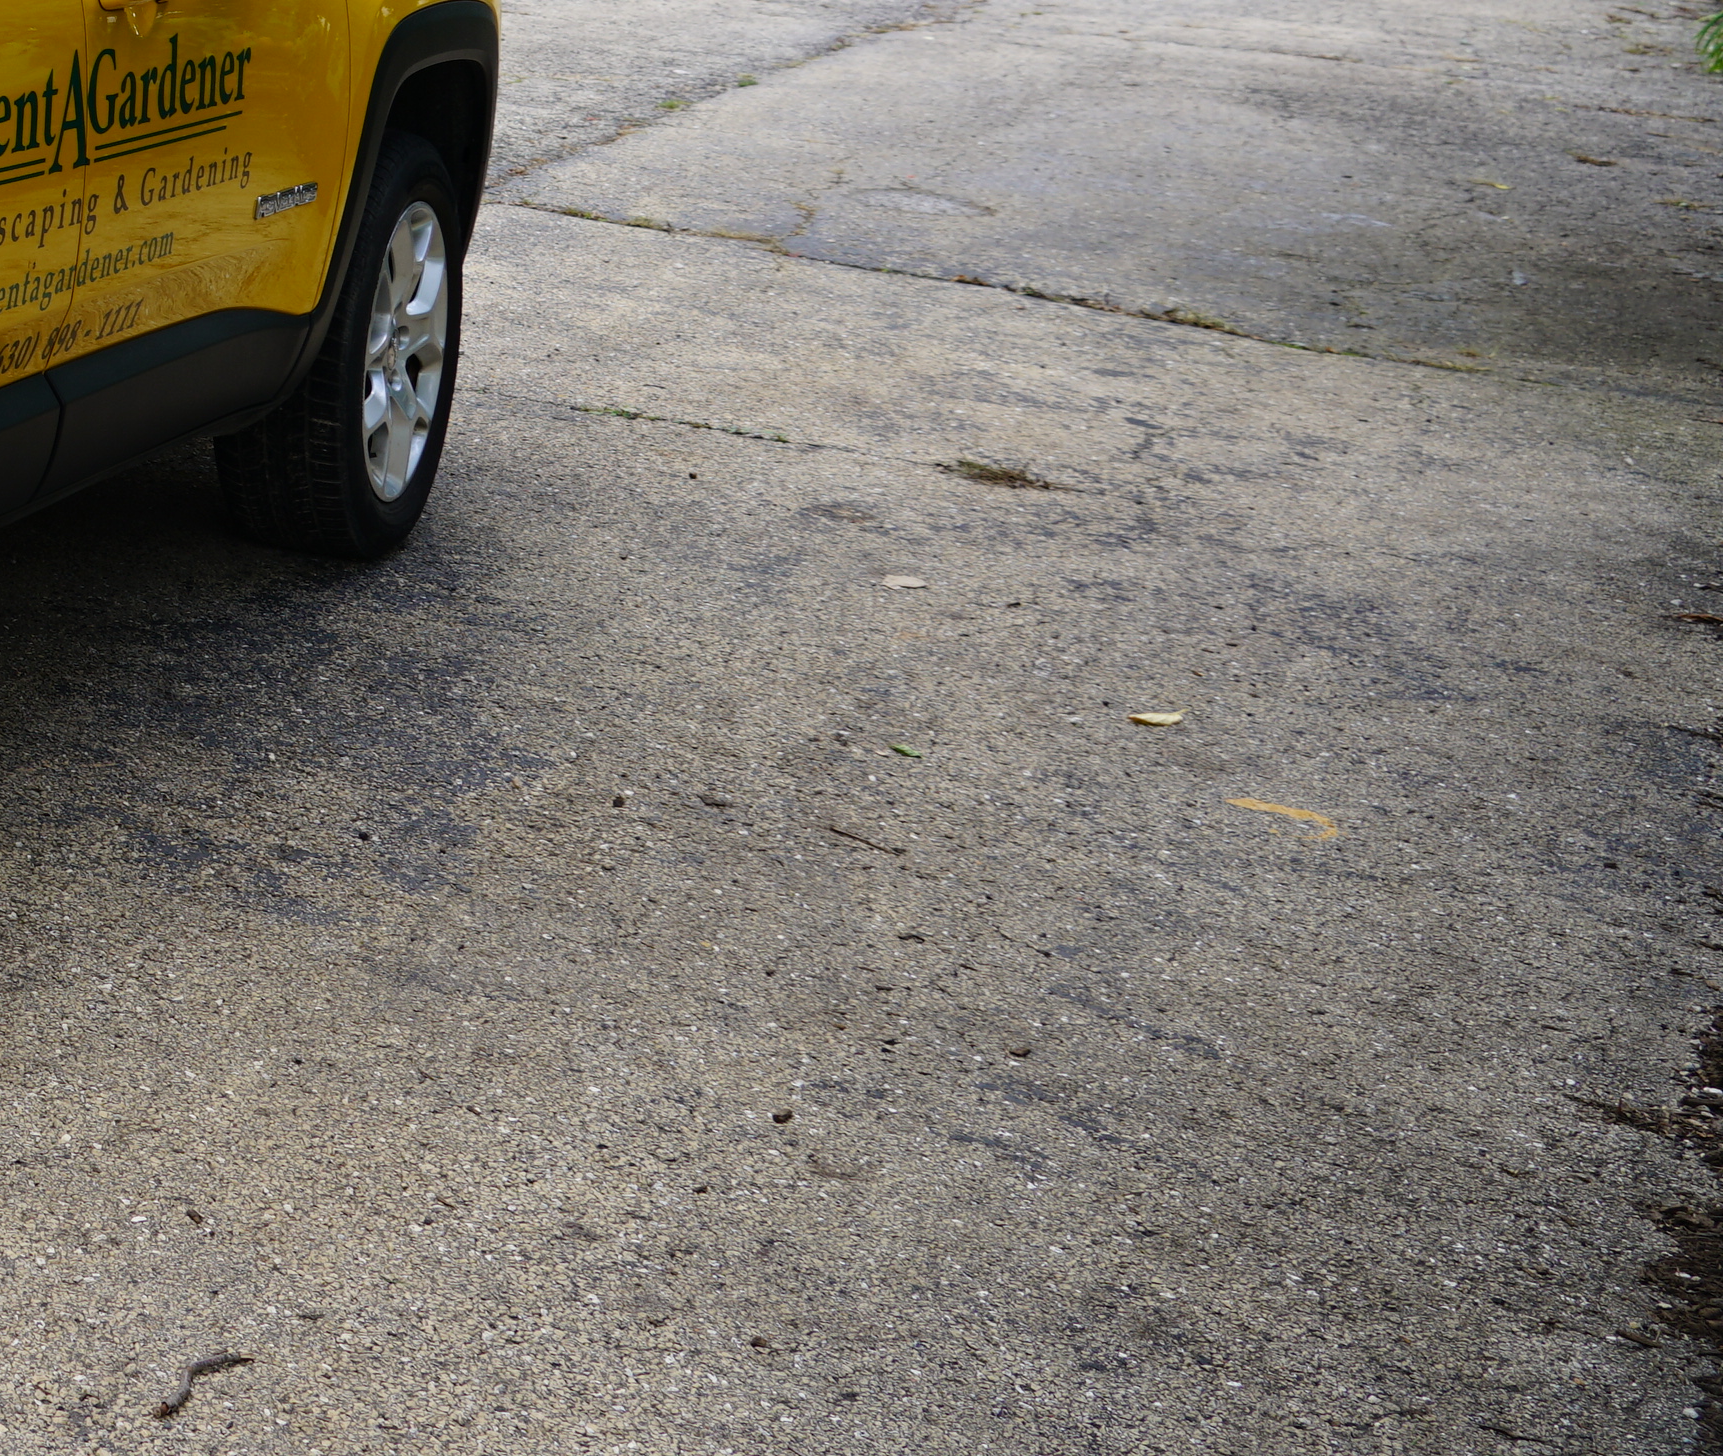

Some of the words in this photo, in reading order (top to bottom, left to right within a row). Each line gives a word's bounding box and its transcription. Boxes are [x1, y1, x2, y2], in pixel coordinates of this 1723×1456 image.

[113, 174, 129, 214] &
[140, 148, 253, 206] Gardening
[41, 319, 83, 360] 898
[95, 297, 145, 341] 1111
